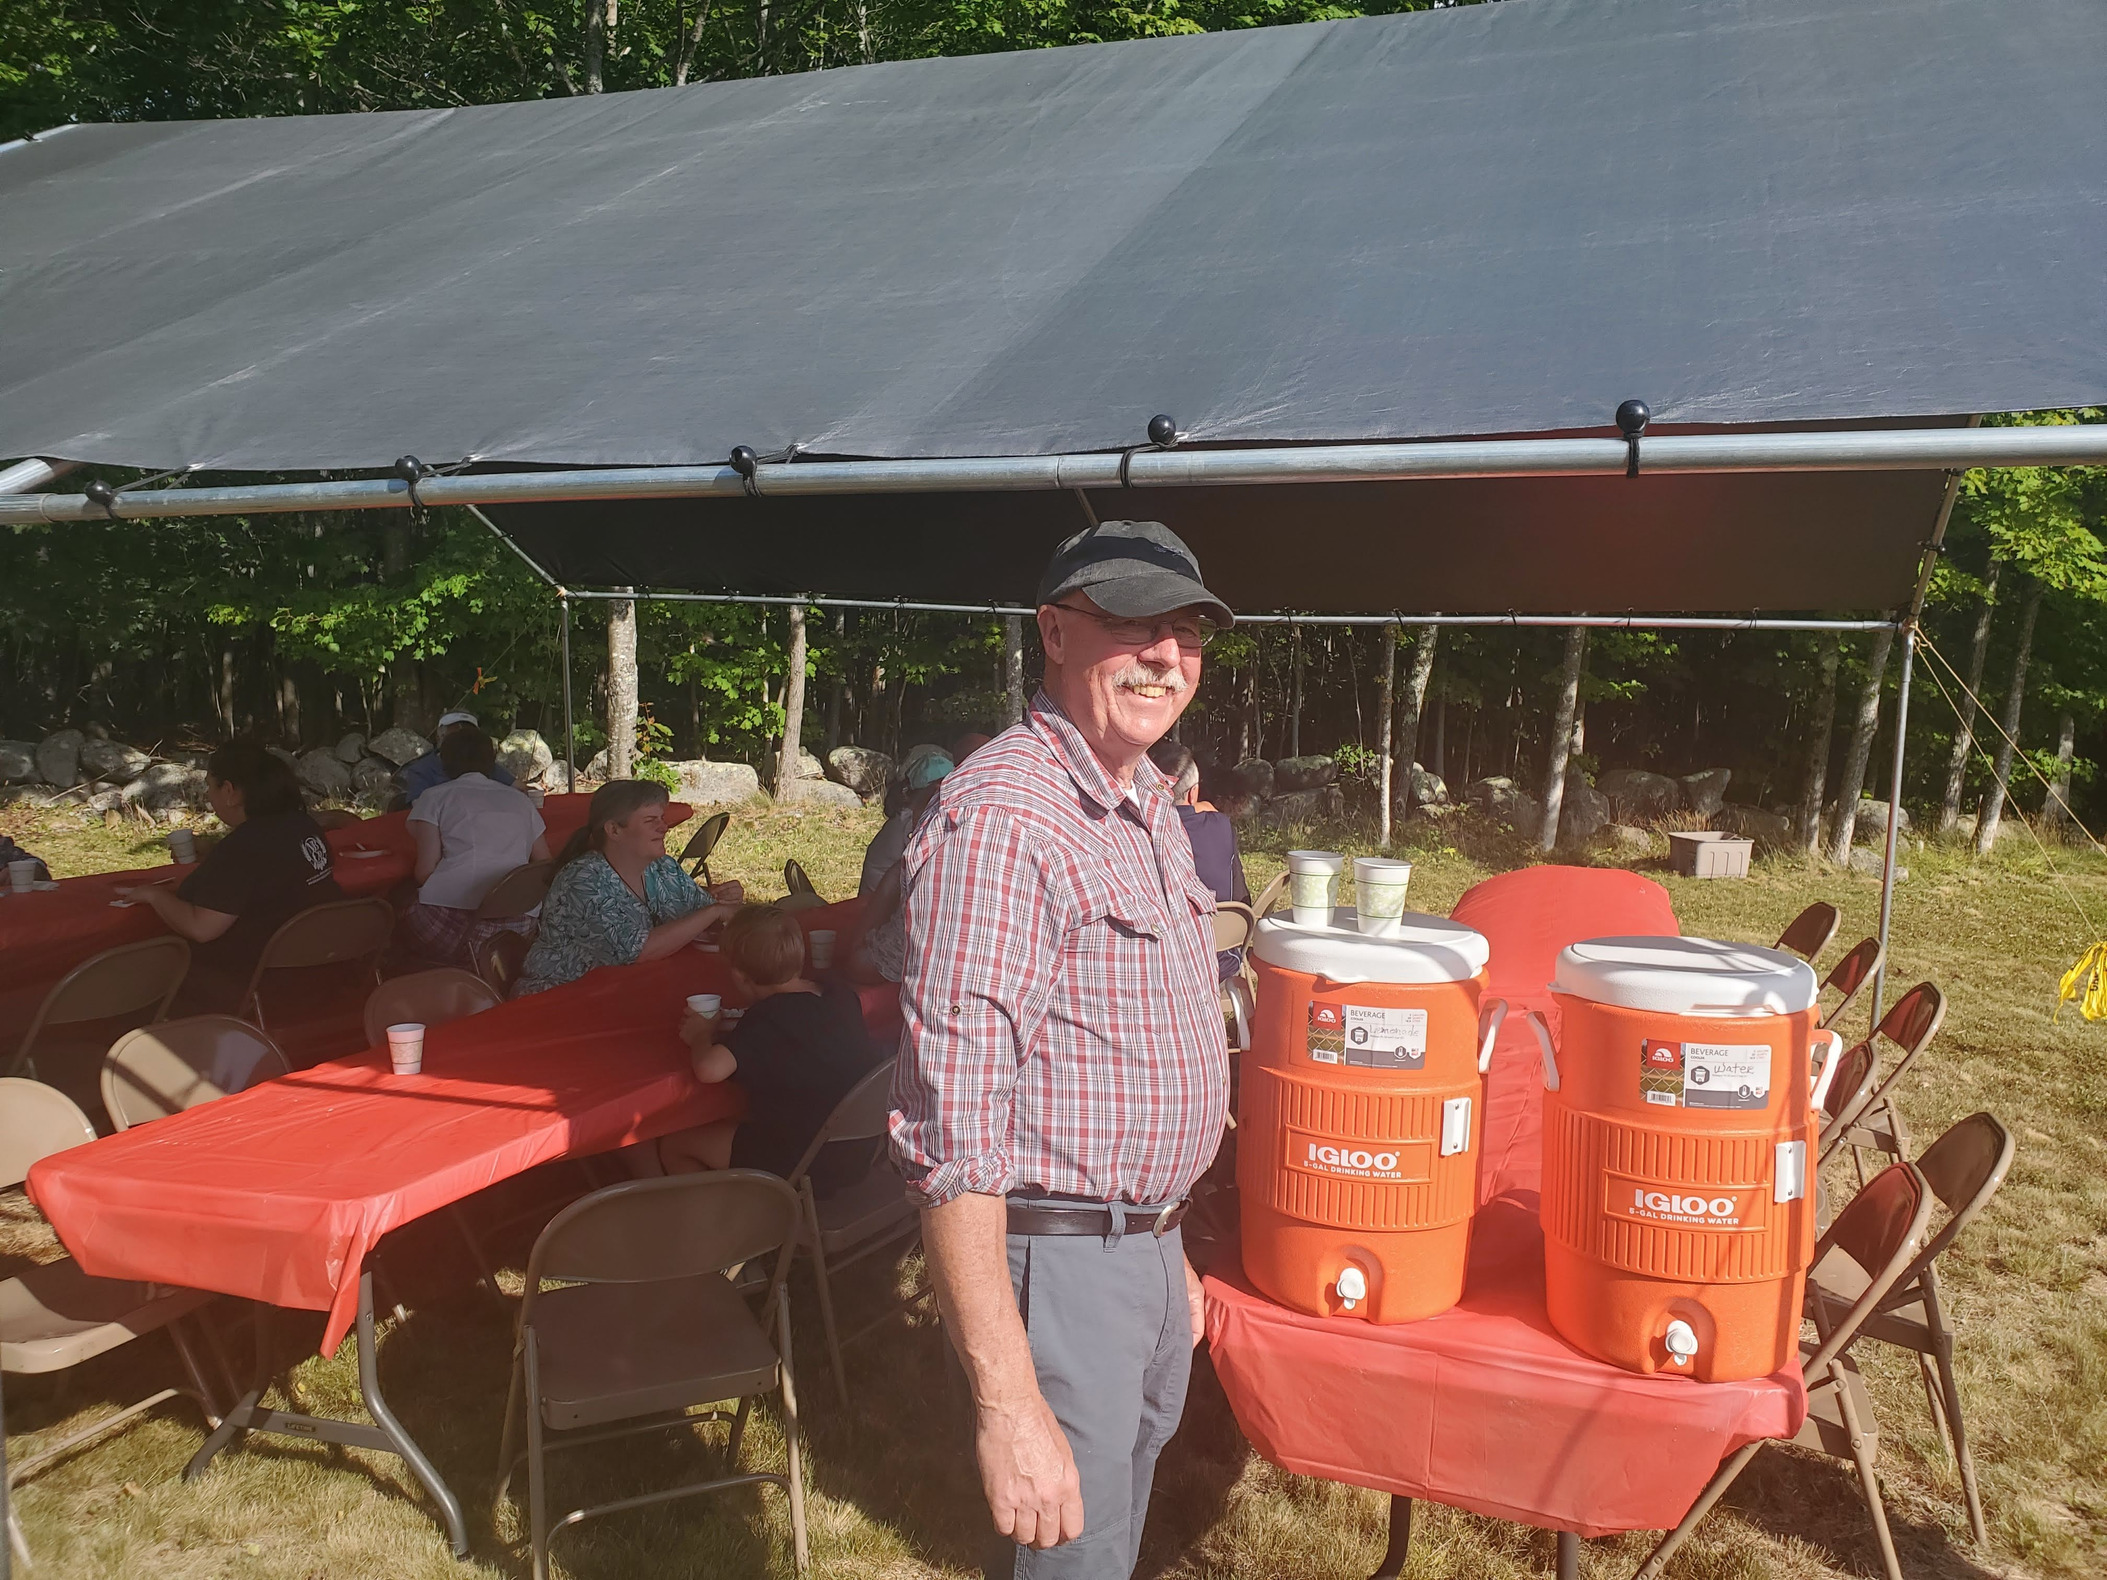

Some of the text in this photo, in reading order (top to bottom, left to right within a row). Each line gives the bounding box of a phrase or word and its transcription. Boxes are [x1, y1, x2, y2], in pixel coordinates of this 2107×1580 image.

[1350, 1009, 1386, 1020] BEVERAGE
[1651, 1055, 1675, 1063] IGLOO
[1690, 1047, 1729, 1057] BEVERAGE
[1308, 1142, 1398, 1171] IGLOO
[1303, 1160, 1402, 1179] 5-GAL DRINKING WATER
[1635, 1188, 1735, 1217] IGLOO
[1628, 1207, 1740, 1225] 5-GAL DRINKING WATER
